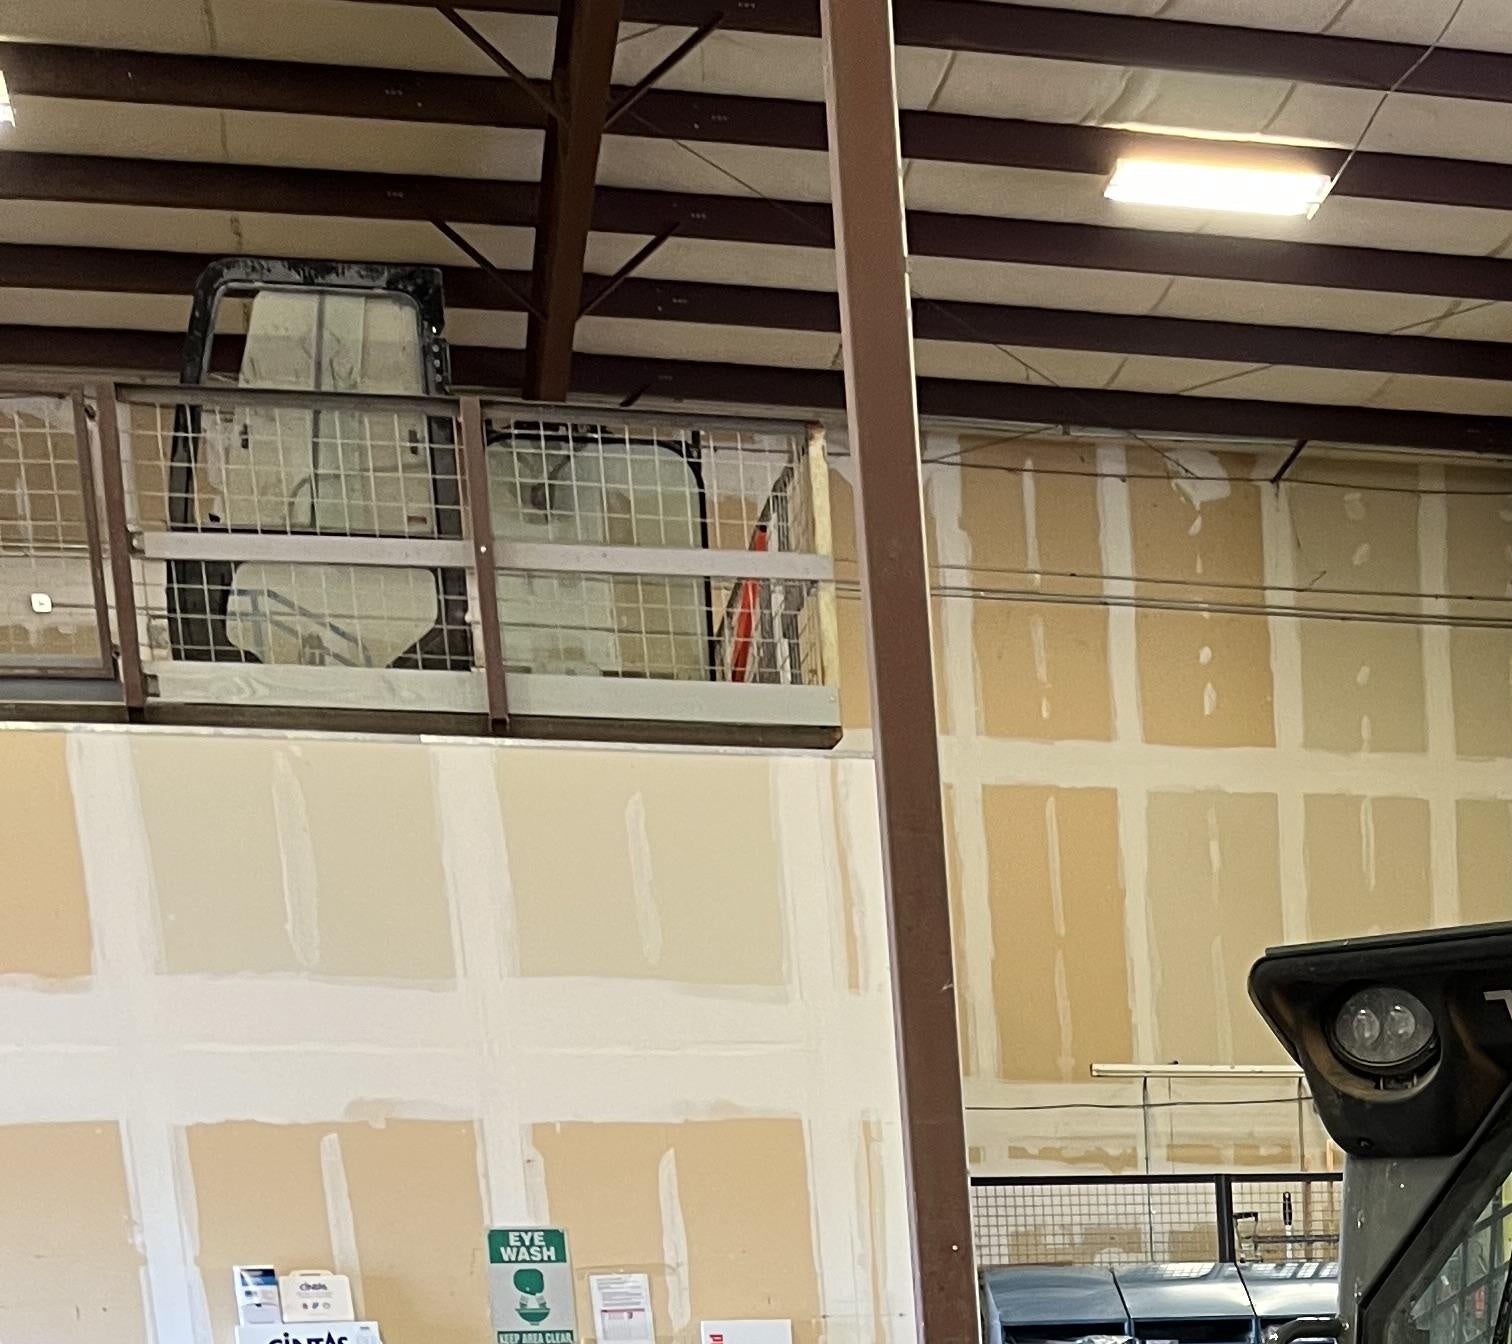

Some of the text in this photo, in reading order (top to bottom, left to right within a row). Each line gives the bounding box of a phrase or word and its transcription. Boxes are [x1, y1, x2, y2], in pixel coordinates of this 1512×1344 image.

[508, 1231, 546, 1247] EYE
[500, 1246, 557, 1261] WASH
[499, 1330, 573, 1344] KEEP AREA CLEAR
